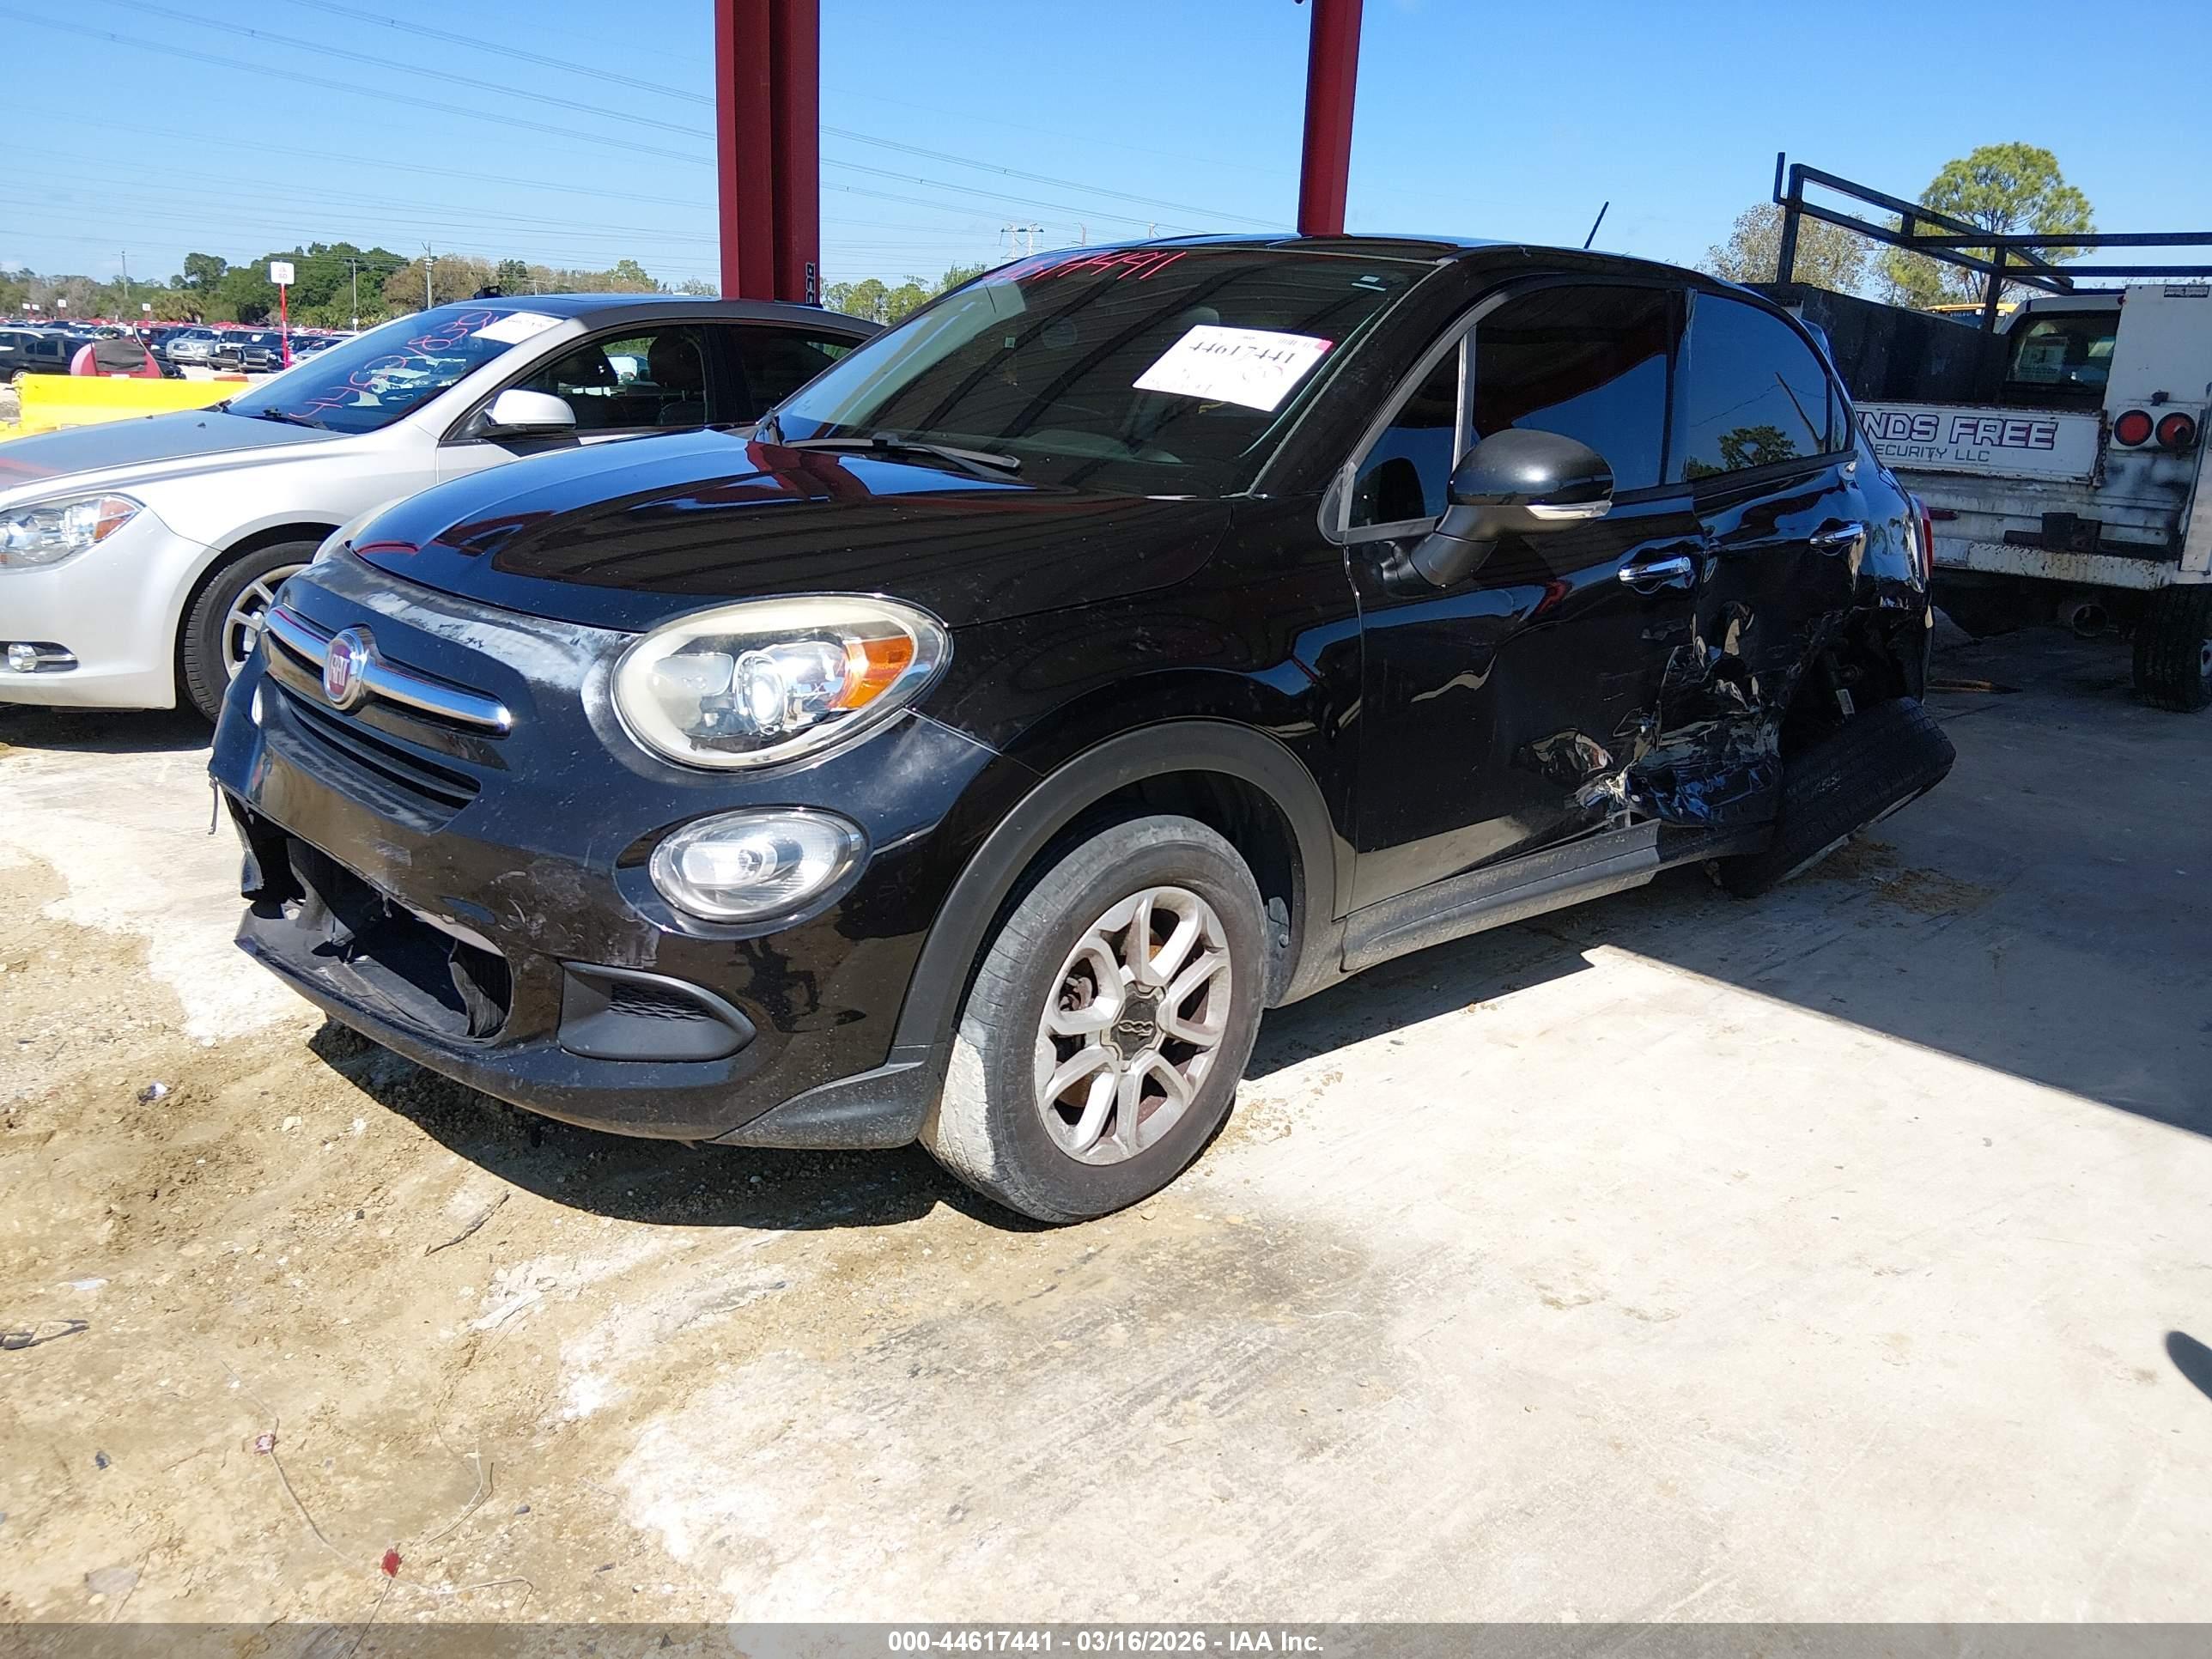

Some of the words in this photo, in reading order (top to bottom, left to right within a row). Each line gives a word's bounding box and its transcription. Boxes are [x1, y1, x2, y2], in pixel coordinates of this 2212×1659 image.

[1948, 416, 2059, 451] FREE
[1871, 443, 1948, 461] ECURITY
[1954, 449, 1990, 463] LLC
